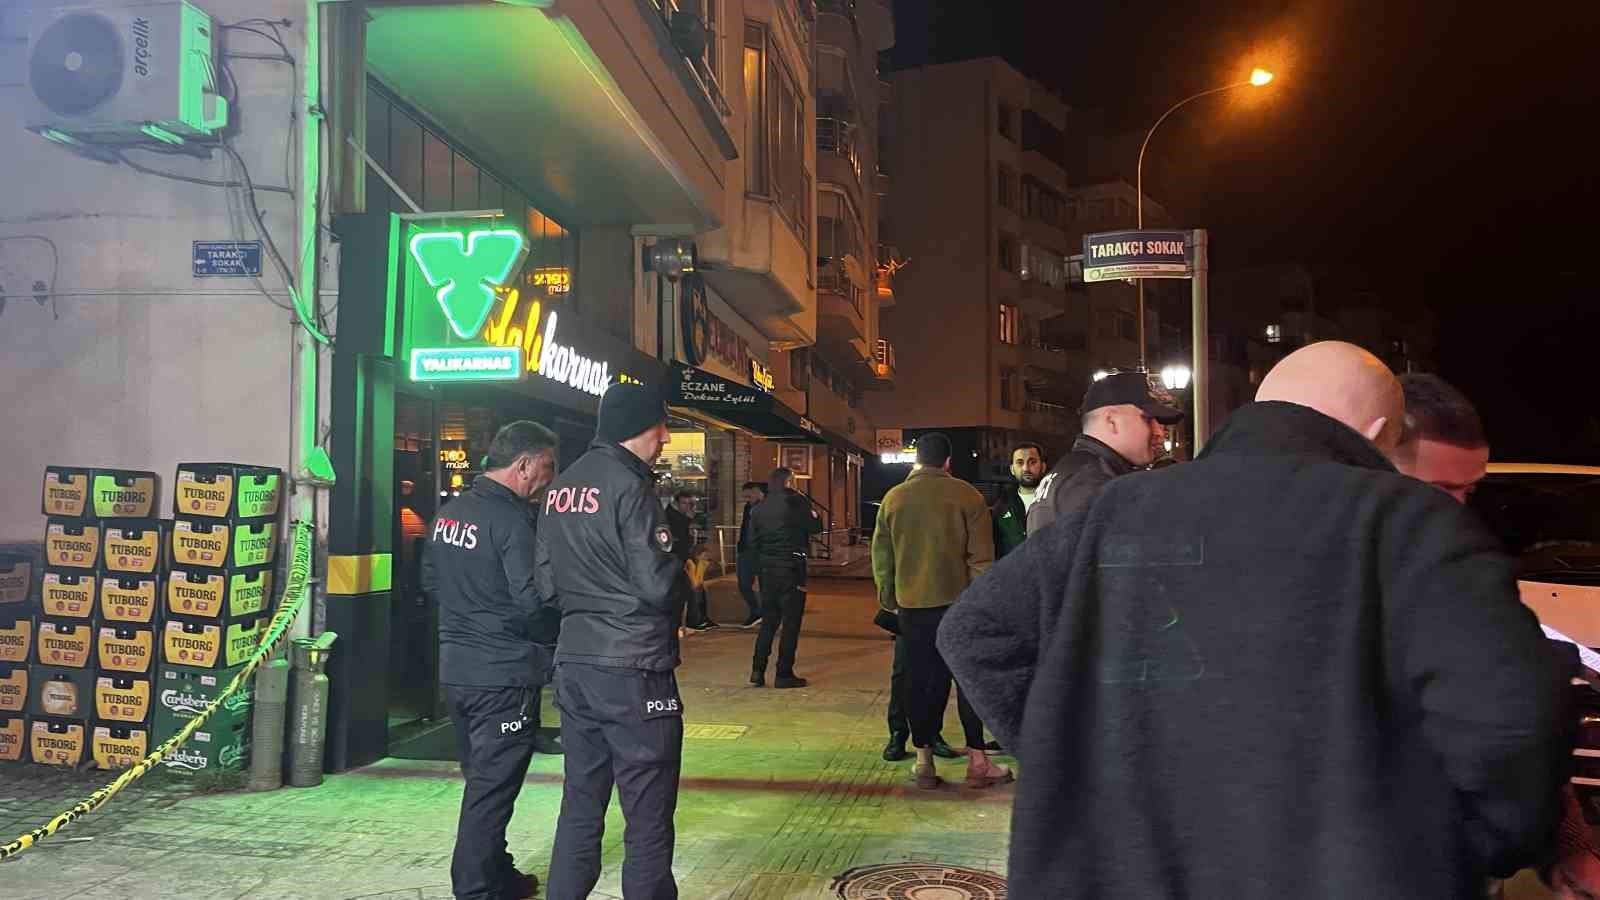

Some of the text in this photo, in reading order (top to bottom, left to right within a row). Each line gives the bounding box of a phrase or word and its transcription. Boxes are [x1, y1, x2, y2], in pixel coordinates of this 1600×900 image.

[133, 17, 151, 76] arçelik
[1091, 241, 1184, 258] TARAKÇI SOKAK
[422, 357, 512, 372] YALIKARNAS
[681, 382, 725, 392] ECZANE
[50, 488, 81, 500] TUBORG
[102, 490, 146, 503] TUBORG
[184, 488, 225, 501] TUBORG
[52, 540, 92, 552] TUBORG
[111, 544, 152, 557] TUBORG
[180, 537, 221, 551] TUBORG
[49, 589, 88, 602] TUBORG
[108, 594, 149, 606] TUBORG
[176, 587, 216, 600] TUBORG
[45, 639, 84, 651] TUBORG
[104, 643, 145, 656] TUBORG
[172, 637, 213, 651] TUBORG
[103, 693, 142, 706] TUBORG
[37, 737, 76, 750] TUBORG
[100, 743, 139, 756] TUBORG
